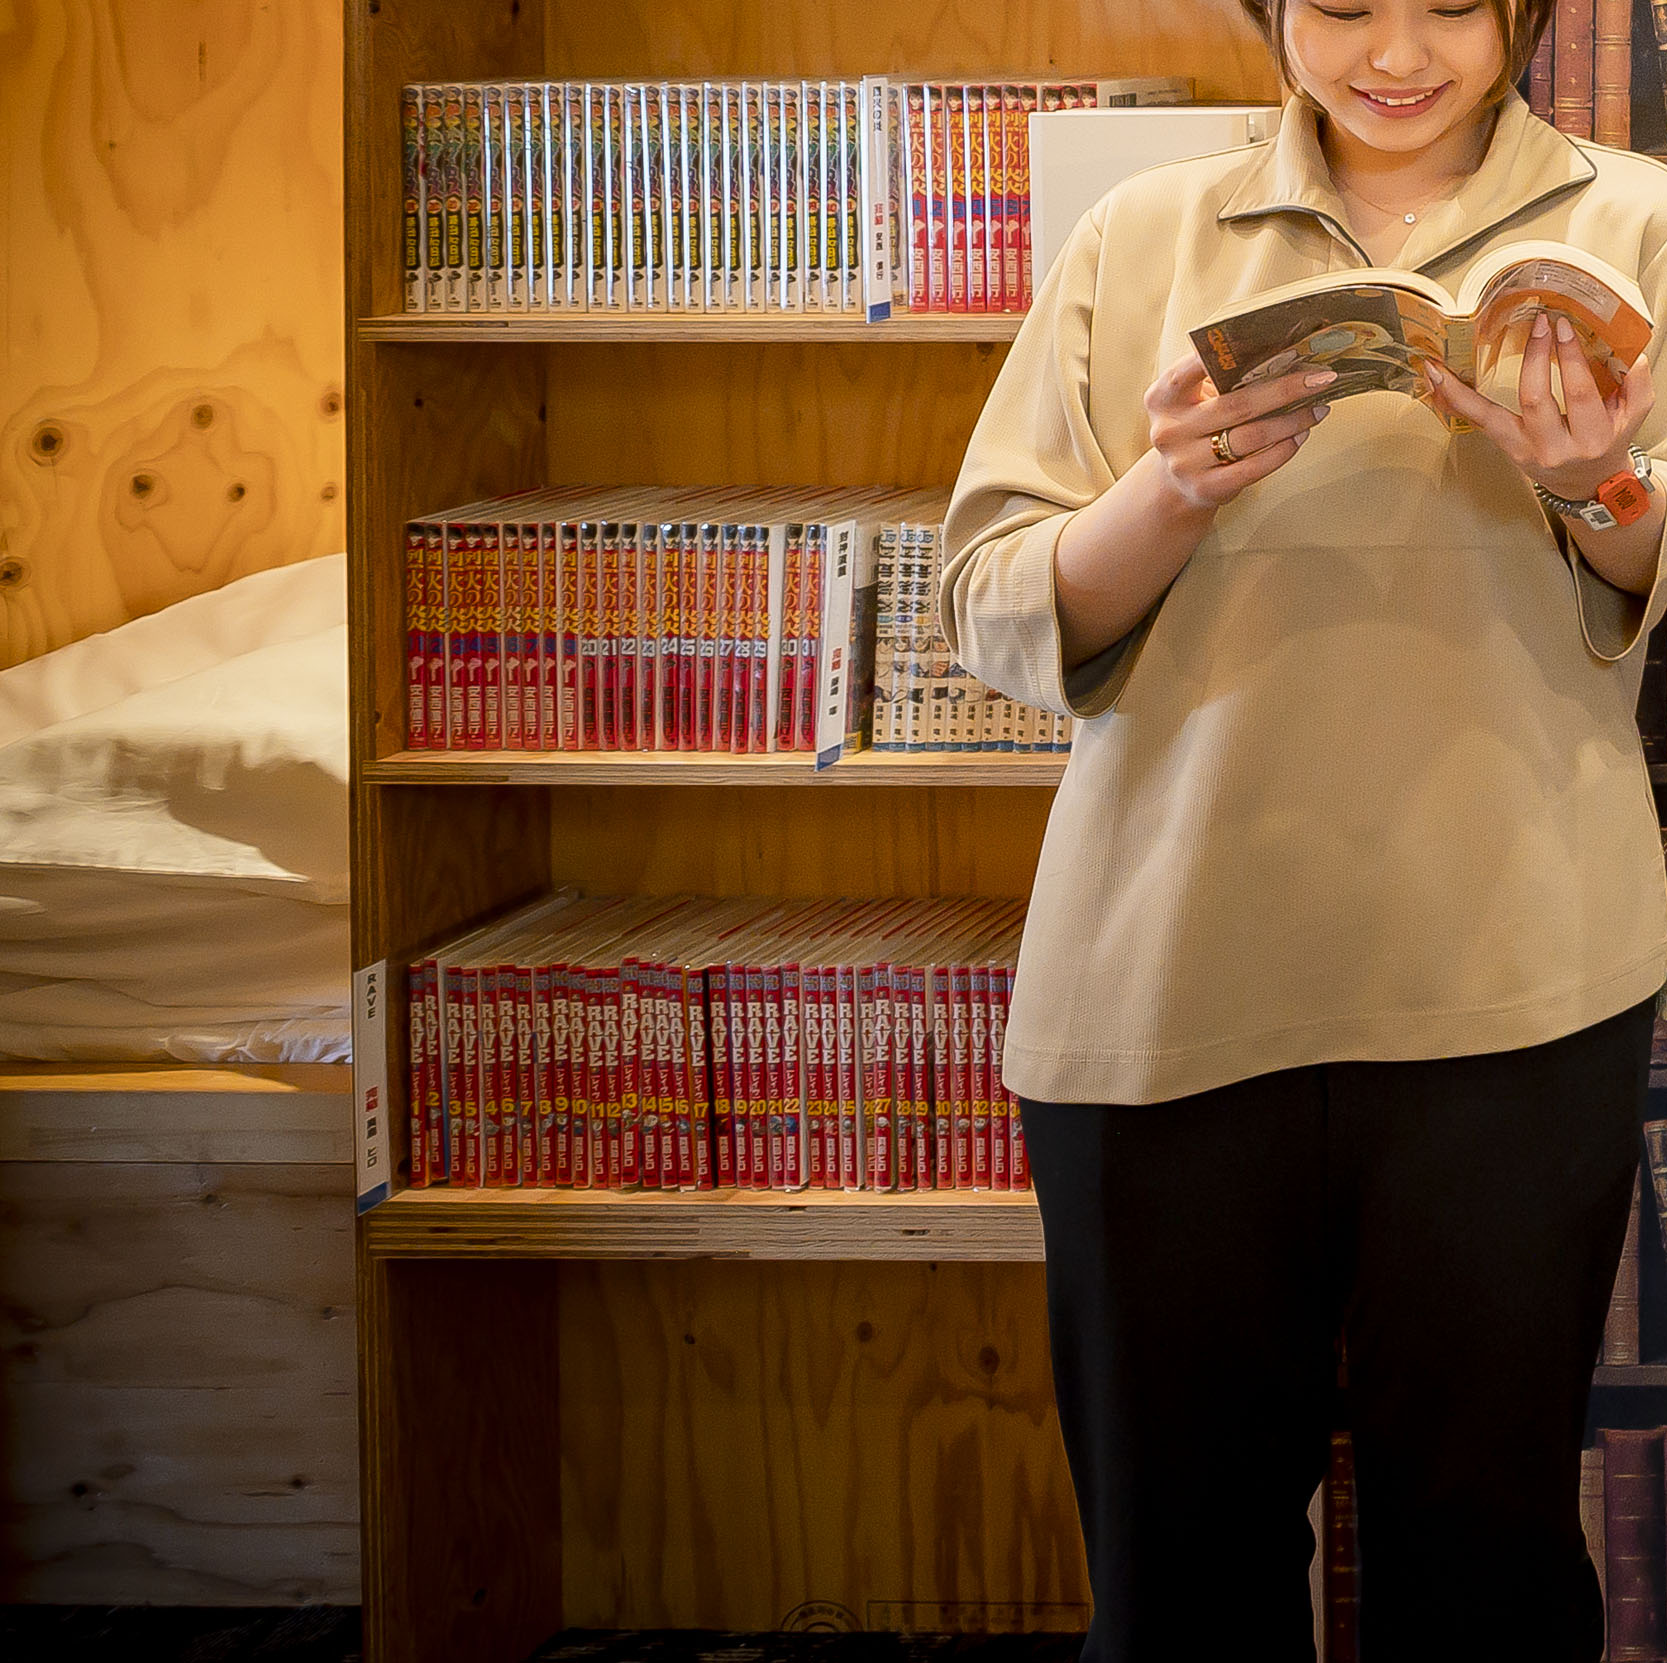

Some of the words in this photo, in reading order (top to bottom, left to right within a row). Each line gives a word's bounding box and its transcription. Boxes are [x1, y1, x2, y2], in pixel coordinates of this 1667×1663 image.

[801, 639, 816, 657] 31
[367, 973, 377, 1020] RAVE
[424, 995, 438, 1057] RAVE
[622, 994, 638, 1056] RAVE
[428, 1092, 439, 1107] 2
[621, 1093, 638, 1108] 13
[367, 1146, 377, 1169] ヒロ
